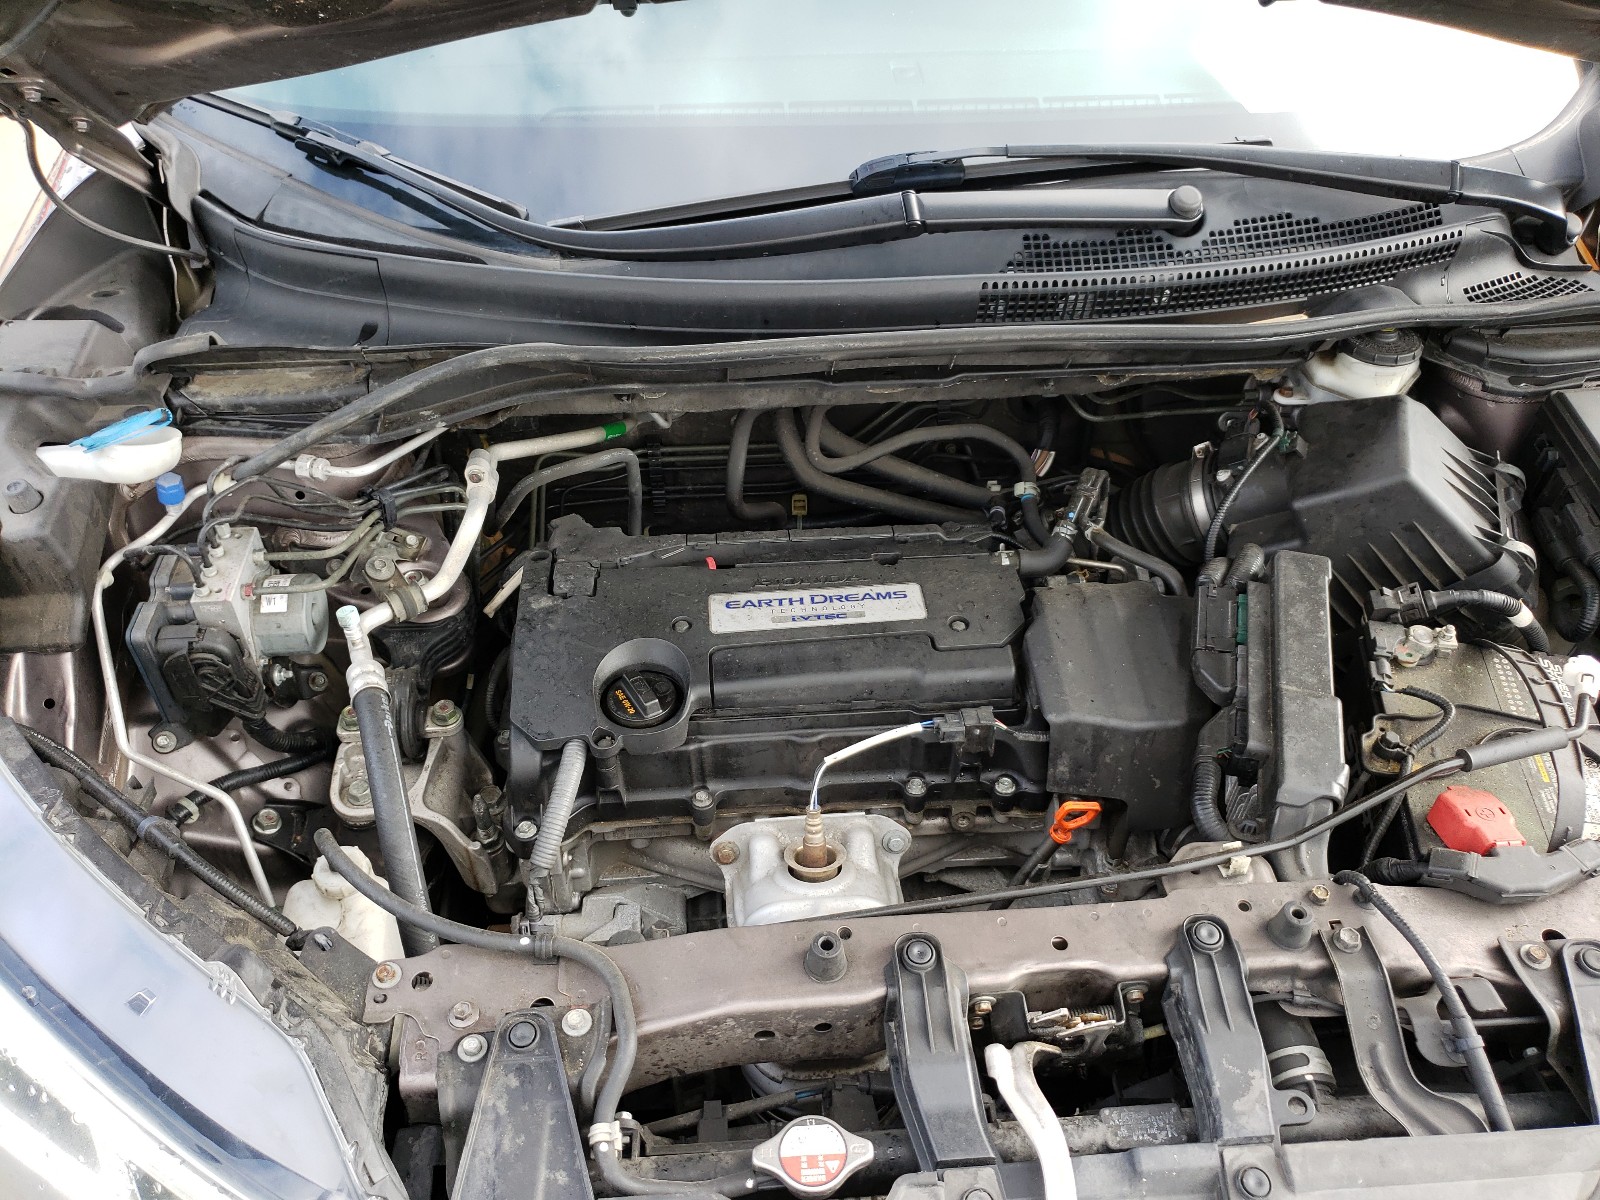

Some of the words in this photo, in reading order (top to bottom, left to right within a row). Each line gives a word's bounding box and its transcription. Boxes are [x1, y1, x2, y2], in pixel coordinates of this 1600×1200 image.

[725, 596, 804, 610] EARTH
[809, 590, 909, 605] DREAMS
[771, 603, 866, 614] TECHNOLOGY
[615, 689, 626, 701] SAE
